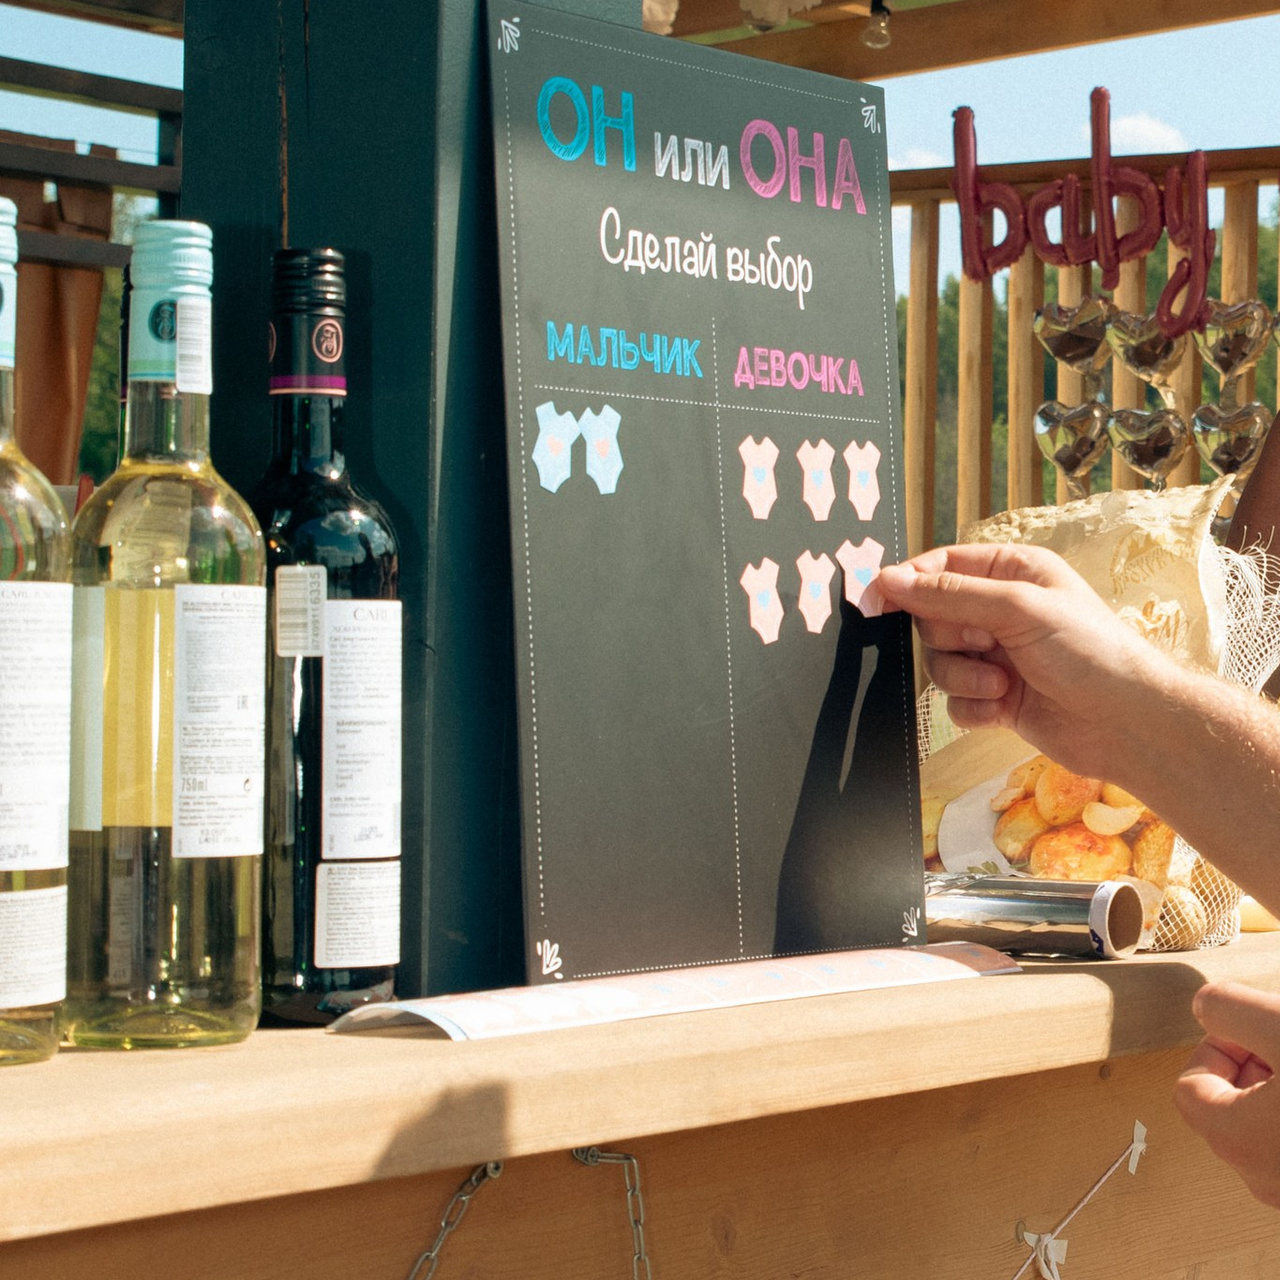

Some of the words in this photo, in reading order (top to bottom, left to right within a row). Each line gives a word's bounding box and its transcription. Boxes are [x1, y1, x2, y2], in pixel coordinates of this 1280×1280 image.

[537, 76, 637, 172] ОН
[739, 119, 867, 215] ОНА
[600, 206, 718, 279] Сделай
[726, 235, 814, 310] выбор
[951, 85, 1217, 340] baby
[546, 320, 704, 378] МАЛЬЧИК
[733, 346, 865, 397] ДЕВОЧКА
